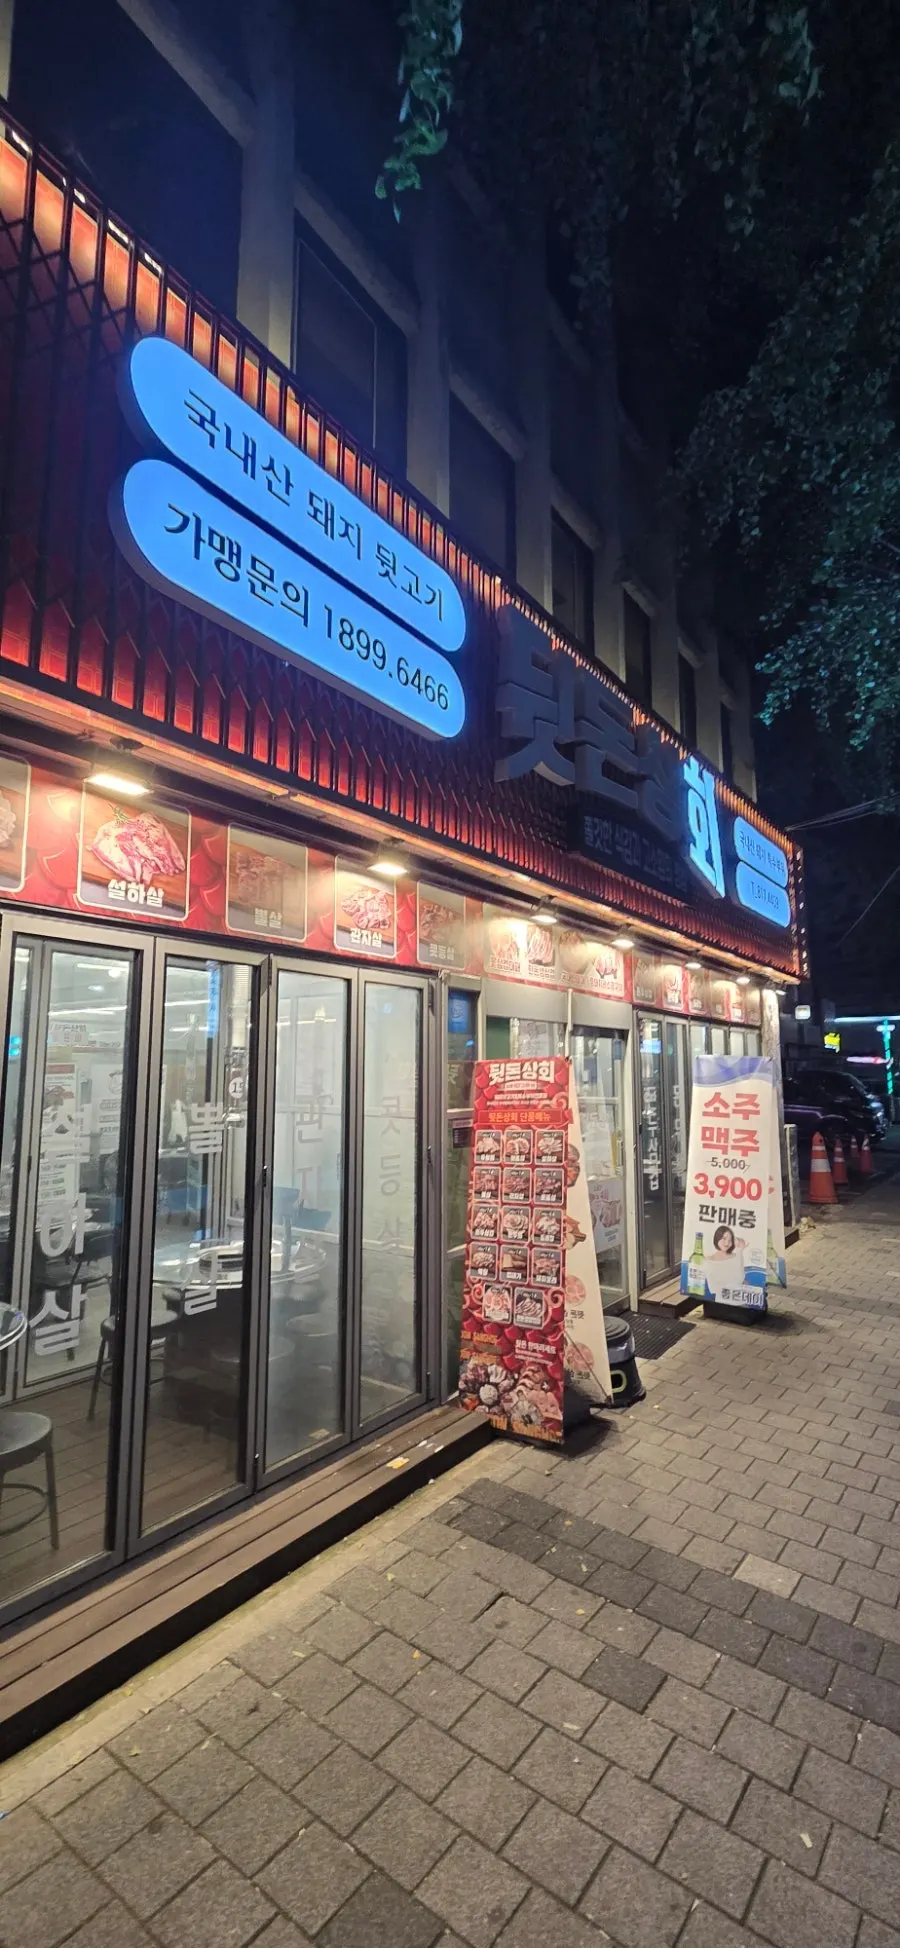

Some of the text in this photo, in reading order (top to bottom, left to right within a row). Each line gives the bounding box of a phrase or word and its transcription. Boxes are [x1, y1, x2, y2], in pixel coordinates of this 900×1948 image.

[184, 388, 444, 621] 국내산 돼지 뒷고기
[163, 503, 449, 711] 가맹문의 1899.6466
[107, 878, 165, 909] 설하살
[349, 927, 383, 949] 관자살
[488, 1059, 555, 1086] 뒷돈상회
[702, 1091, 761, 1121] 소주
[700, 1126, 760, 1158] 맥주
[693, 1172, 763, 1201] 3,900
[698, 1203, 757, 1229] 판매중
[721, 1287, 765, 1308] 좋은데이
